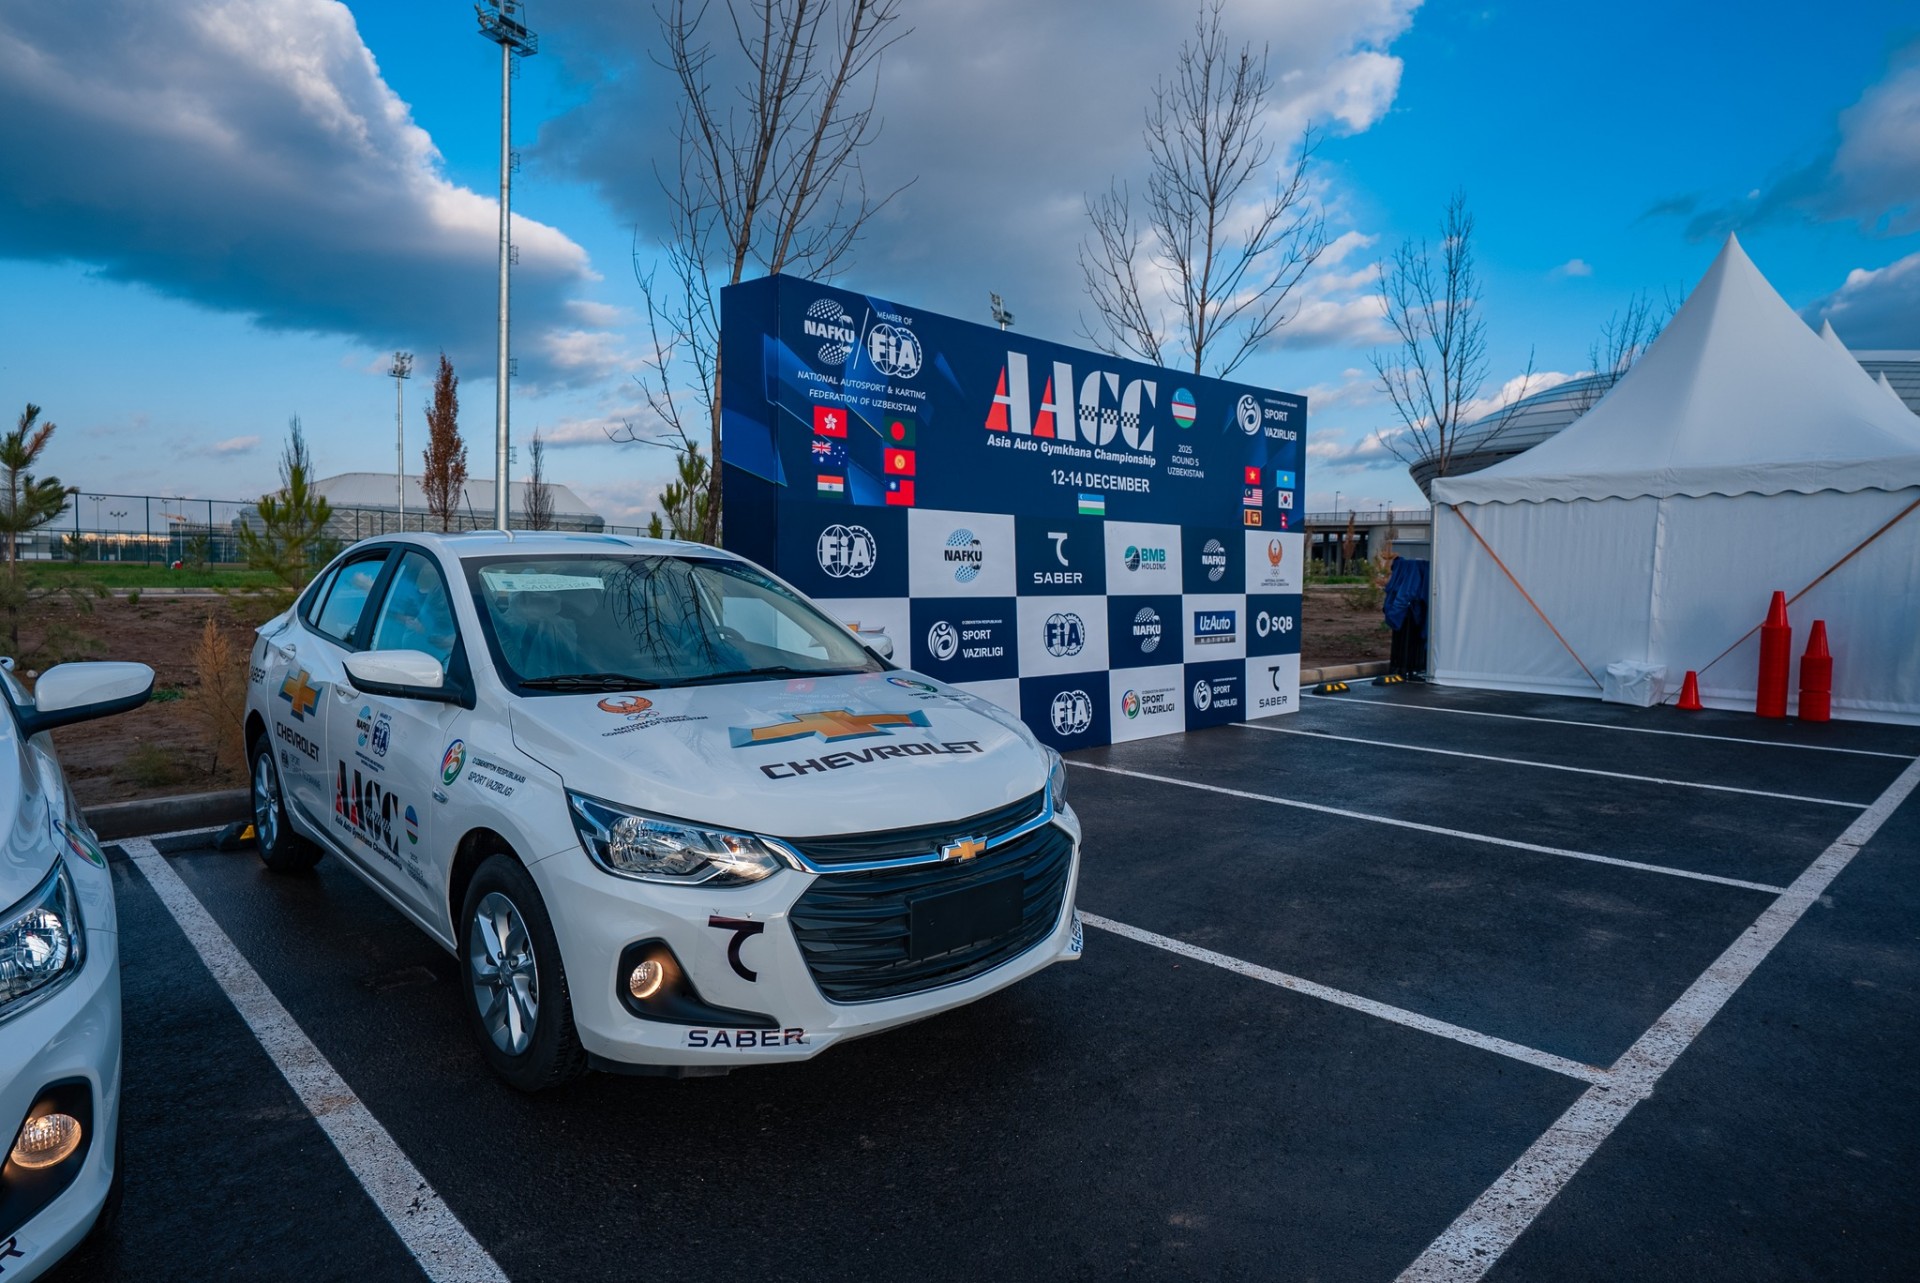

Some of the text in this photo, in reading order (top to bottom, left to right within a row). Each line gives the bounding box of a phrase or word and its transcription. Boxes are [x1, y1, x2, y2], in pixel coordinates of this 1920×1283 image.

[876, 311, 913, 326] MEMBER OF
[804, 319, 855, 344] NAFKU
[797, 370, 927, 400] NATIONAL AUTOSPORT & KARTING
[808, 388, 917, 413] FEDERATION OF UZBEKISTAN
[984, 350, 1158, 452] AACC
[1264, 408, 1289, 422] SPORT
[1264, 426, 1297, 442] VAZIRLIGI
[987, 434, 1156, 468] Asia Auto Gymkhana Championship
[1177, 443, 1193, 455] 2025
[1172, 454, 1200, 467] ROUND 5
[1167, 466, 1204, 479] UZBEKISTAN
[1051, 469, 1150, 493] 12-14 DECEMBER
[943, 549, 983, 563] NAFKU
[1141, 547, 1166, 563] BMB
[1201, 554, 1226, 566] NAFKU
[1141, 562, 1166, 571] HOLDING
[1033, 571, 1083, 585] SABER
[1200, 615, 1231, 631] UzAuto
[1271, 615, 1293, 634] SQB
[962, 629, 992, 641] SPORT
[1133, 624, 1162, 637] NAFKU
[962, 646, 1004, 659] VAZIRLIGI
[1213, 684, 1231, 695] SPORT
[1141, 694, 1165, 705] SPORT
[1213, 697, 1238, 709] VAZIRLIGI
[1258, 695, 1288, 708] SABER
[1142, 703, 1175, 716] VAZIRLIGI
[276, 721, 319, 762] CHEVROLET
[760, 740, 984, 780] CHEVROLET
[467, 771, 515, 798] SPORT VAZIRLIGI
[335, 759, 399, 857] AACC
[688, 1028, 805, 1048] SABER
